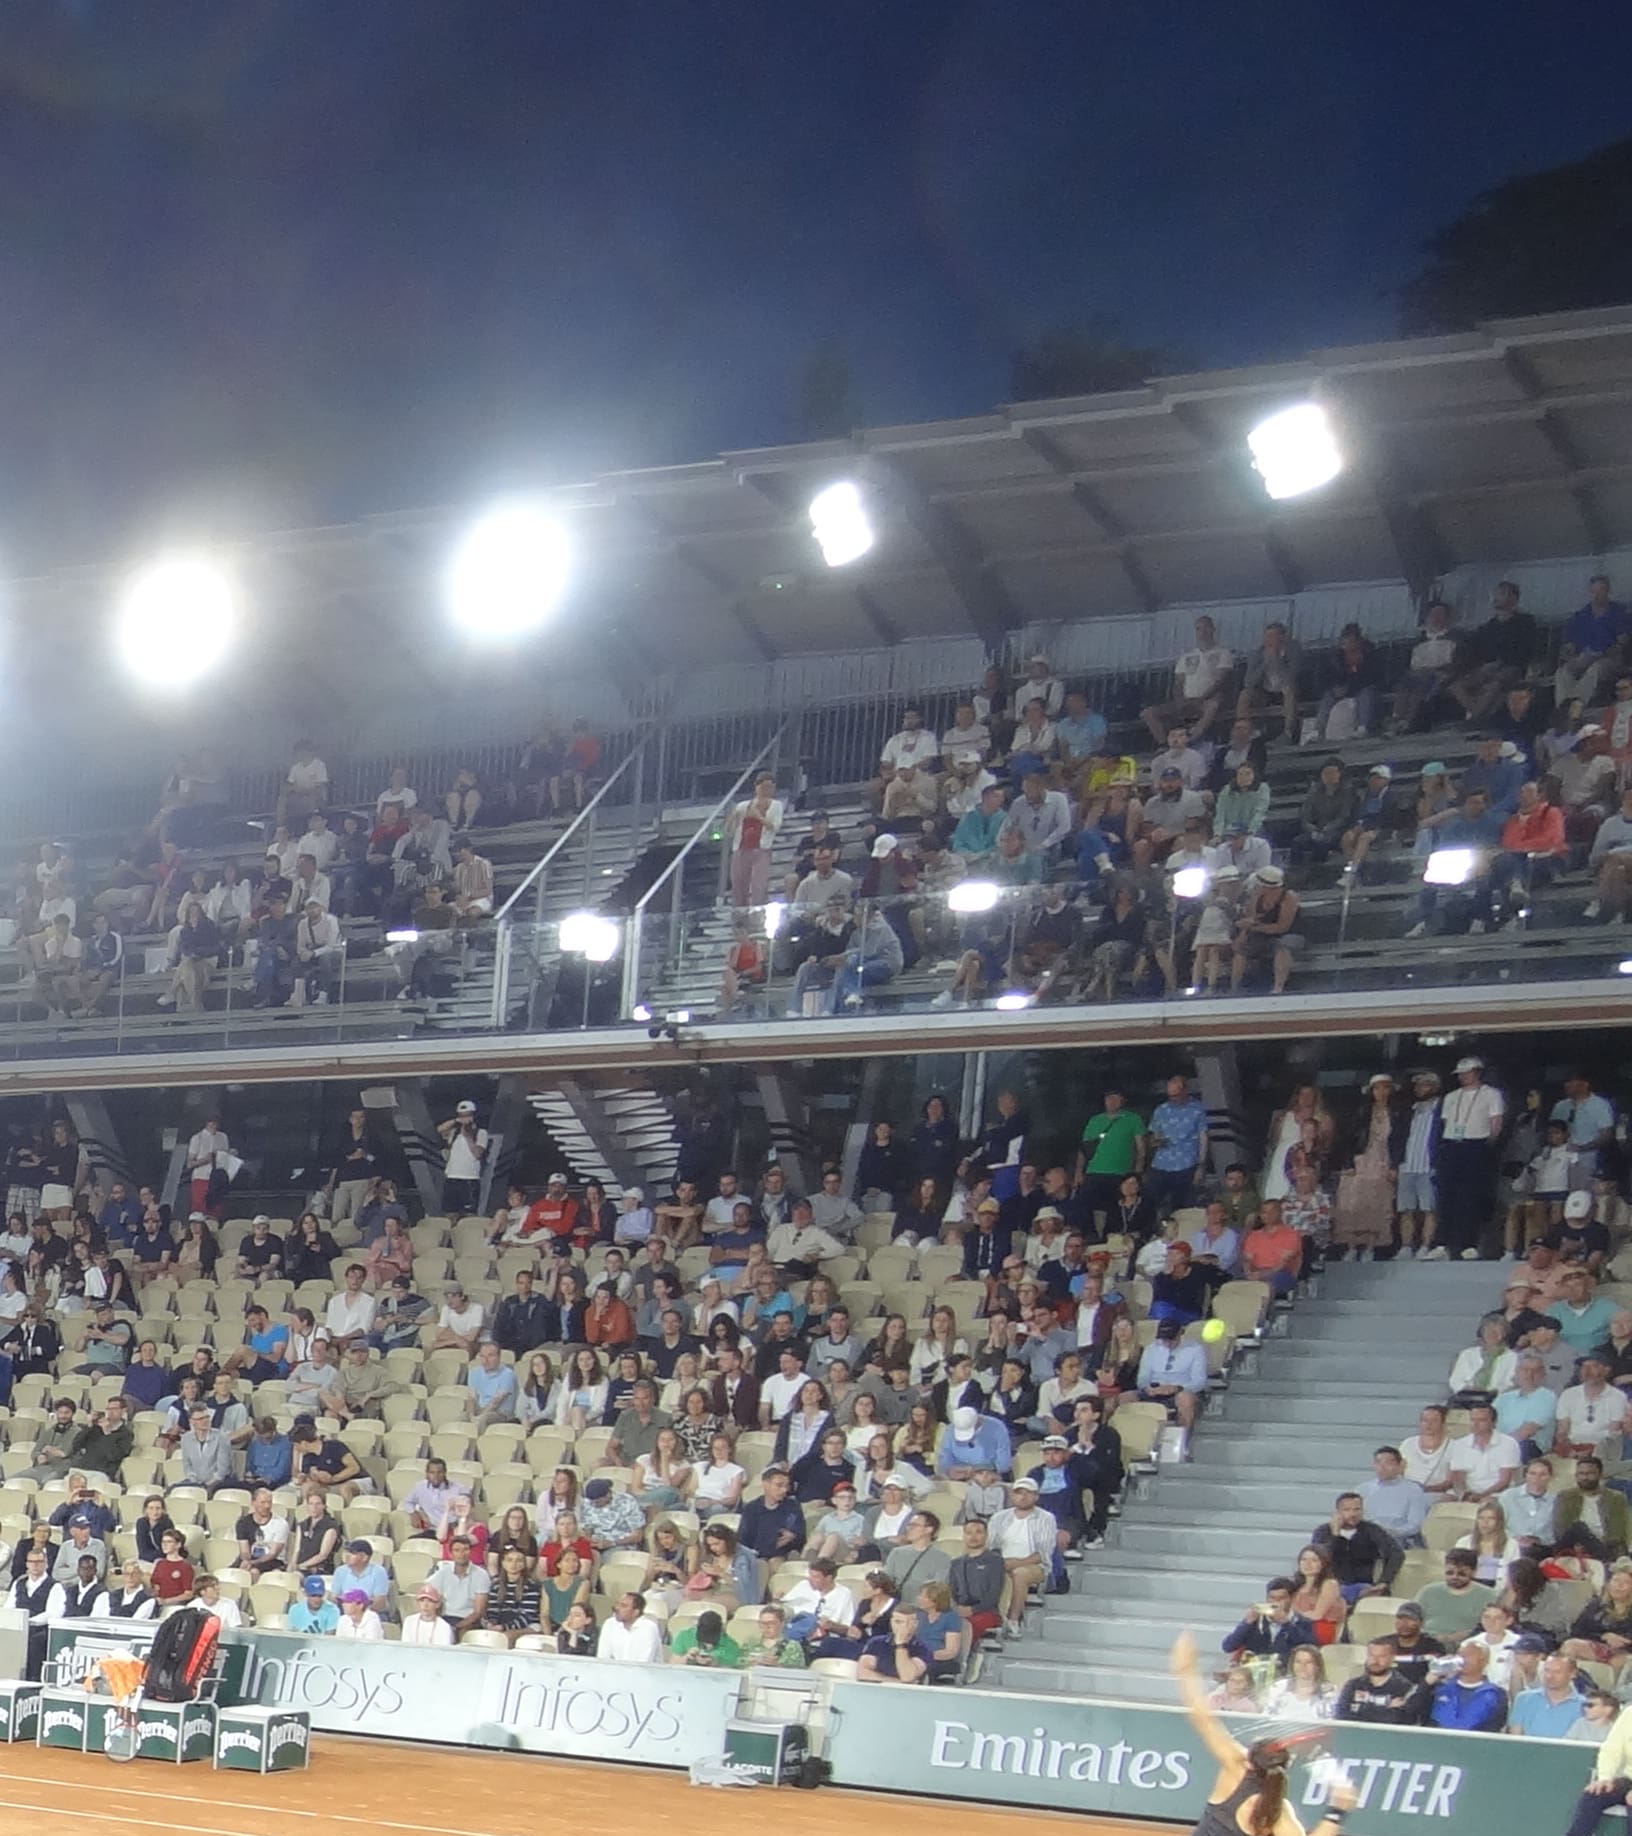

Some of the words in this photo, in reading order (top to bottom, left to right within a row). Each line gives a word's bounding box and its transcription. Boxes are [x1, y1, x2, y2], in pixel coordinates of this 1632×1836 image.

[239, 1643, 407, 1722] Infosys
[498, 1665, 684, 1750] Infosys
[930, 1720, 1191, 1792] Emirates
